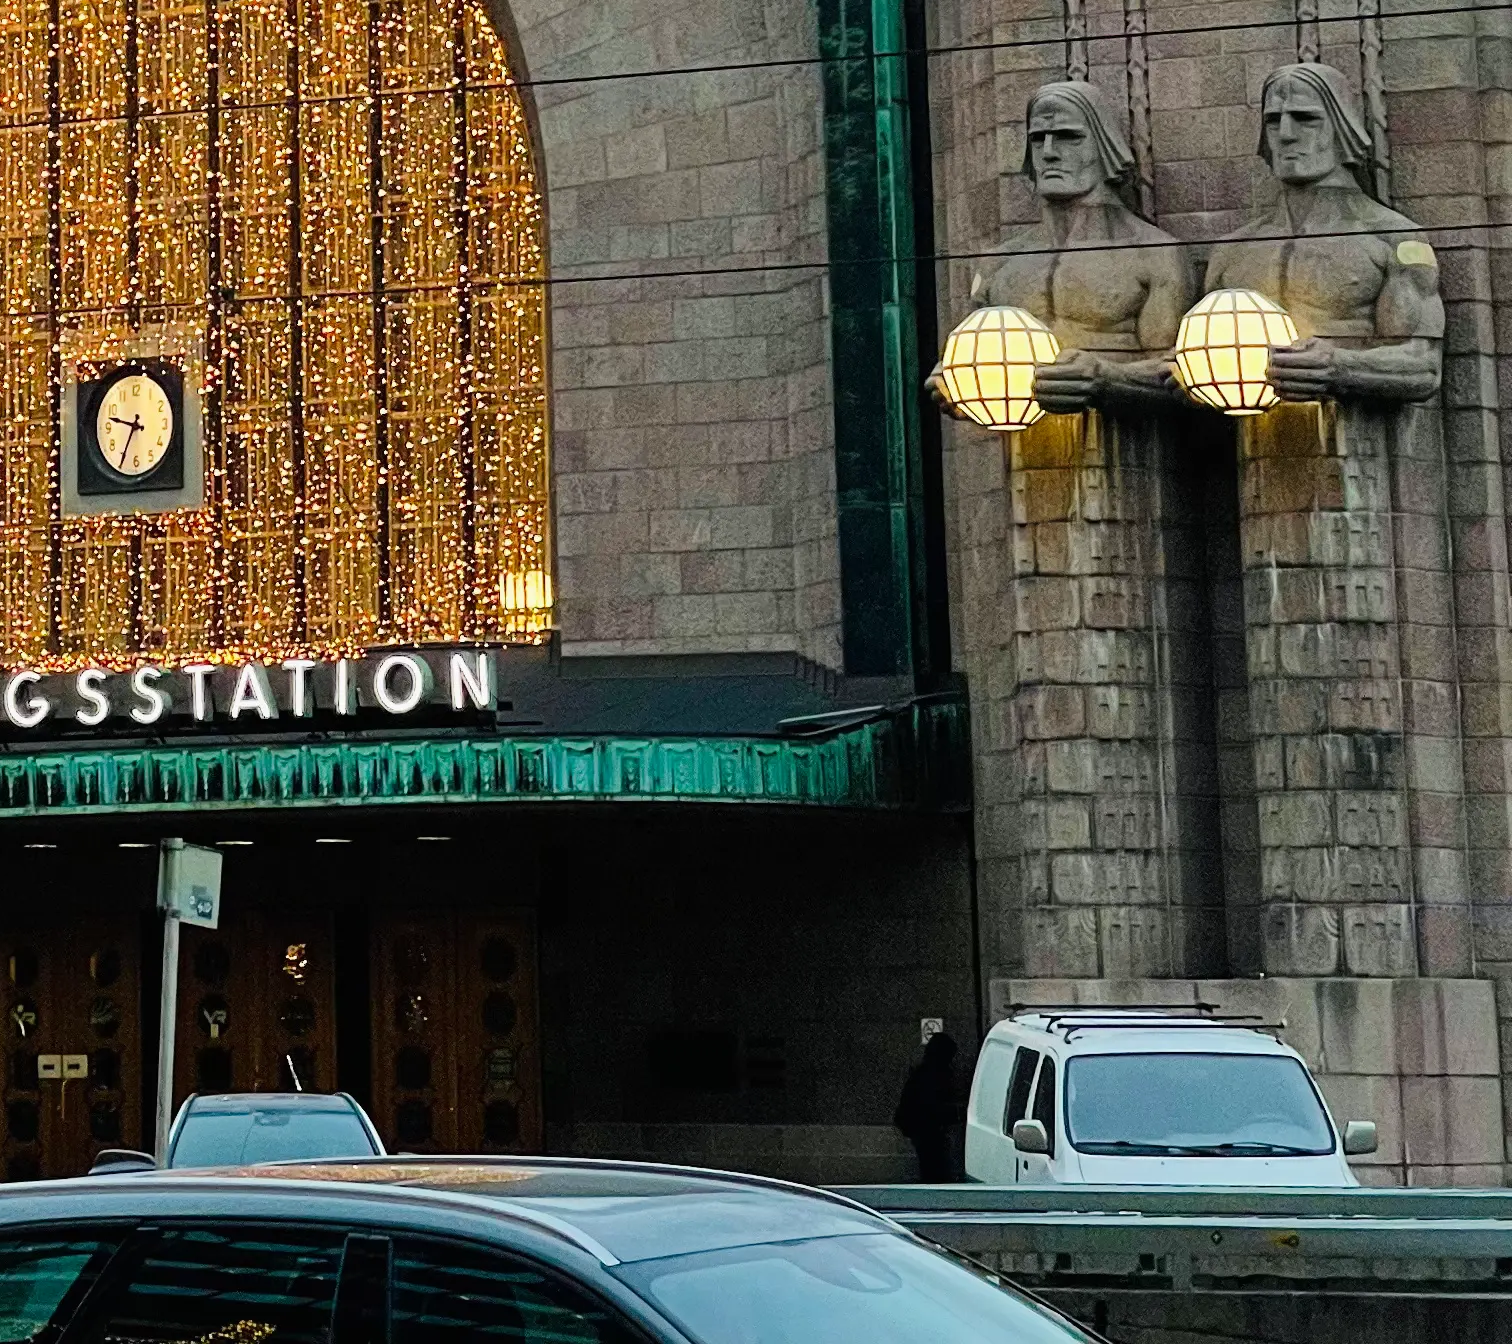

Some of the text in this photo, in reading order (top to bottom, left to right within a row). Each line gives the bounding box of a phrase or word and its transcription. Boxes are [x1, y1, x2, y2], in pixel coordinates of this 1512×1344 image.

[119, 390, 126, 402] 11
[132, 384, 141, 397] 12
[108, 404, 117, 416] 10
[157, 400, 164, 413] 2
[105, 422, 112, 435] 9
[162, 418, 168, 431] 3
[109, 439, 116, 451] 8
[157, 436, 163, 447] 4
[133, 455, 140, 468] 6
[148, 450, 154, 463] 5
